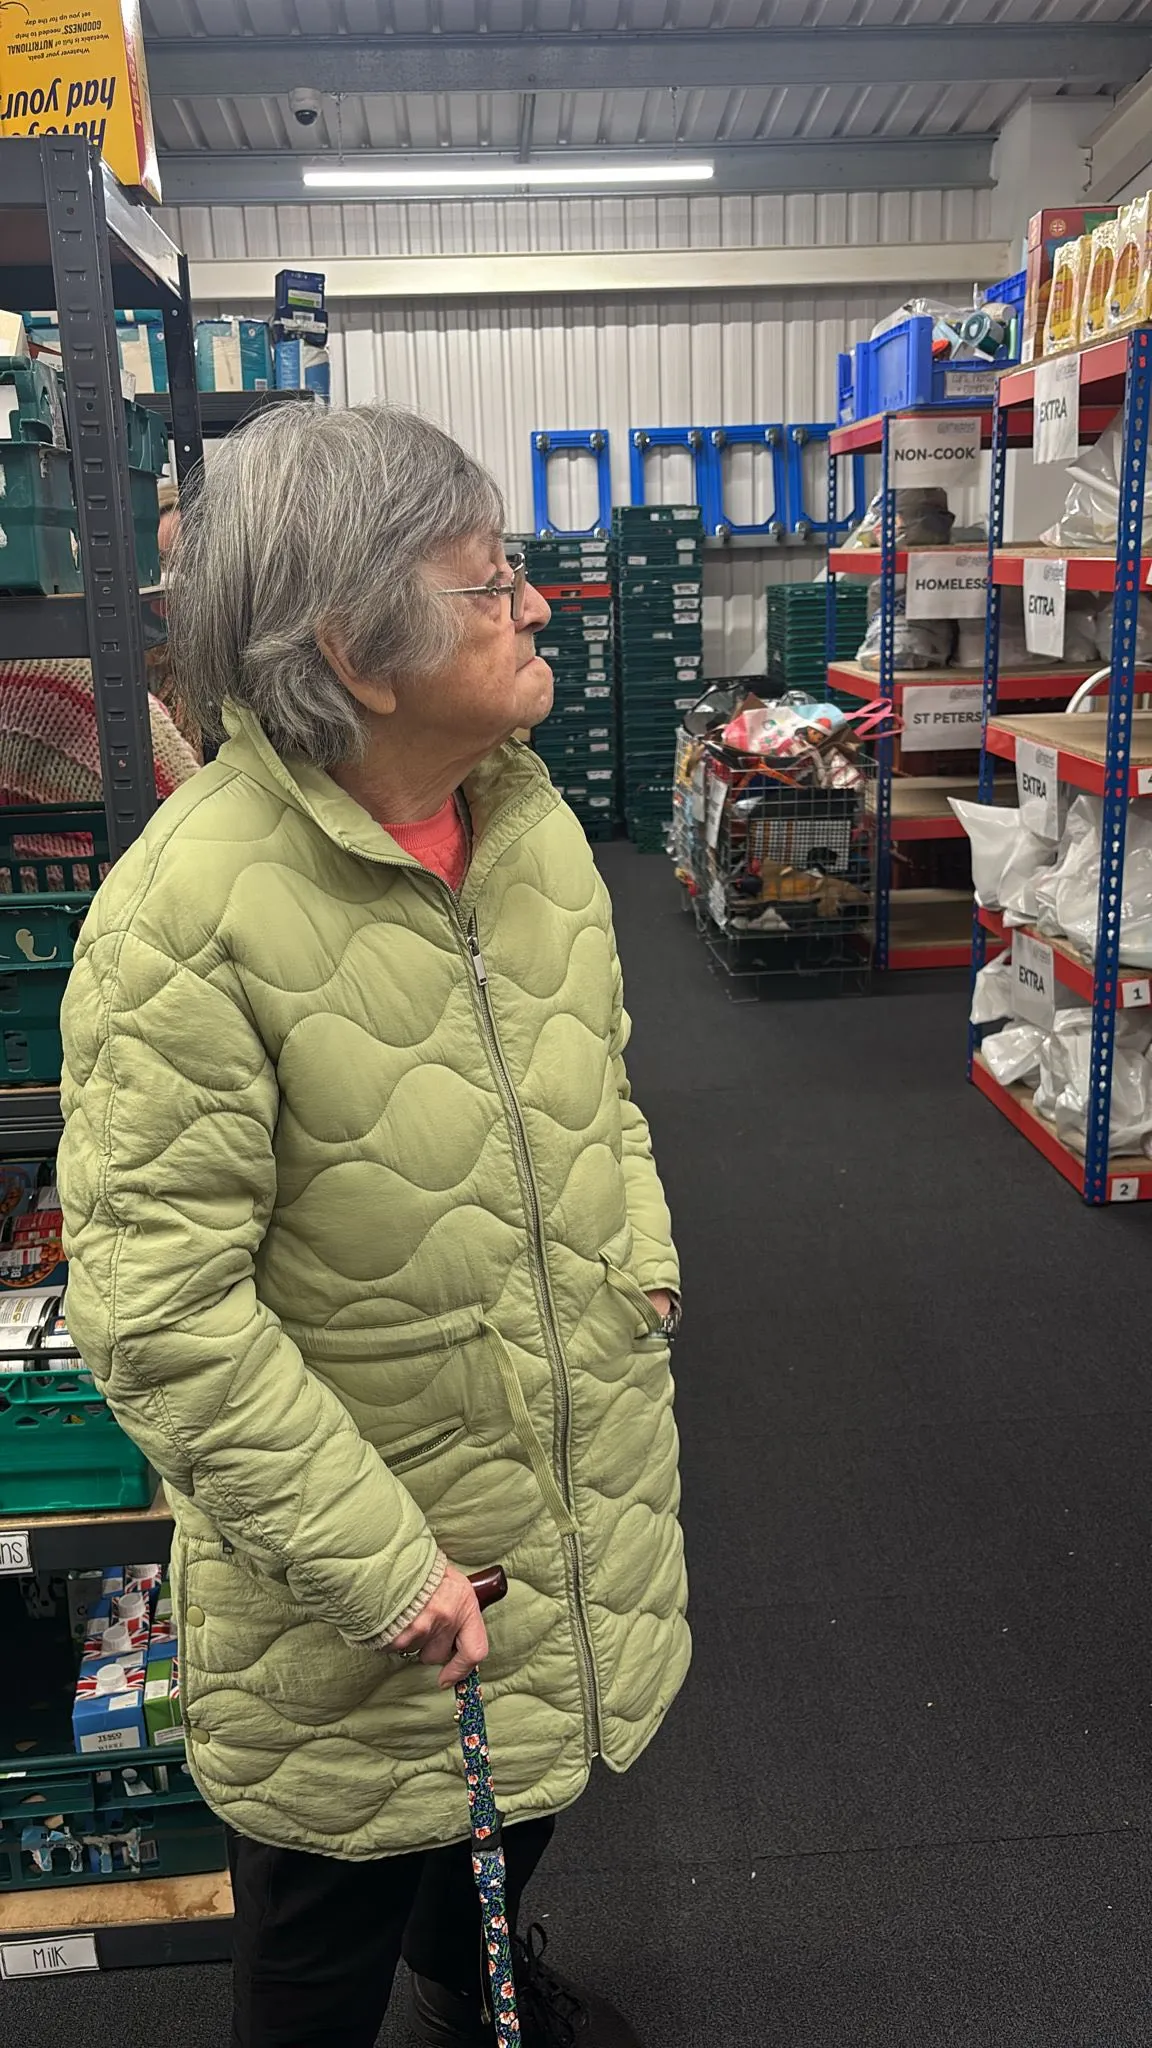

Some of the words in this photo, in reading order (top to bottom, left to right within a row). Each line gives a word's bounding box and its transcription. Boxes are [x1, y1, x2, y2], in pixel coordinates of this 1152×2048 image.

[38, 28, 61, 36] needed
[80, 34, 109, 42] Weetabix
[7, 39, 54, 55] NUTRITIONAL
[62, 38, 74, 46] full
[60, 48, 90, 56] Whatever
[0, 77, 61, 120] your
[65, 77, 116, 118] had
[1039, 397, 1067, 423] EXTRA
[893, 447, 977, 462] NON-COOK
[915, 578, 989, 591] HOMELESS
[1028, 594, 1055, 617] EXTRA
[912, 713, 930, 724] ST
[932, 712, 982, 724] PETERS
[1021, 772, 1047, 800] EXTRA
[1018, 965, 1045, 995] EXTRA
[1132, 987, 1142, 1001] 1
[1119, 1183, 1129, 1196] 2
[0, 1541, 23, 1565] ns
[97, 1732, 122, 1743] TESCO
